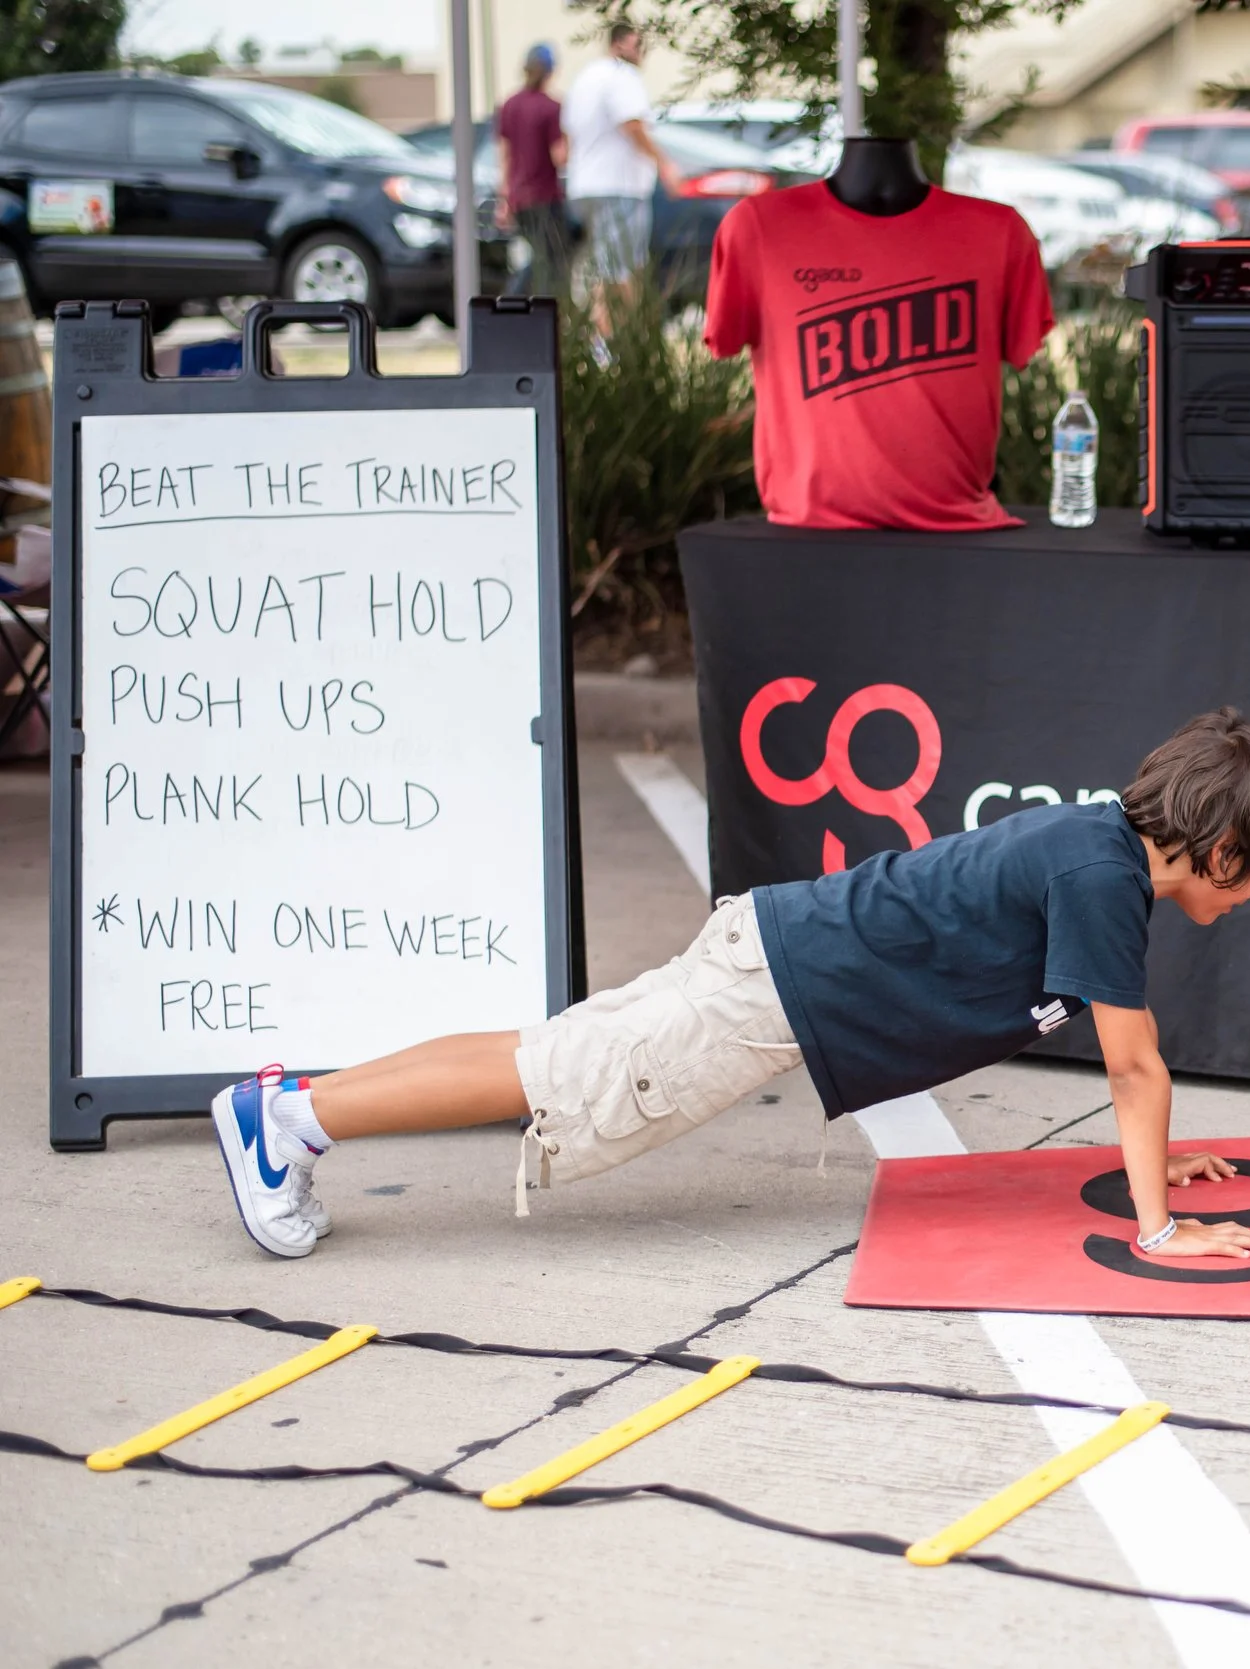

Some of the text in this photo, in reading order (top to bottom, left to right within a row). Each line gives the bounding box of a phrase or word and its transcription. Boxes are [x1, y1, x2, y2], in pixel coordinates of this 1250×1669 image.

[804, 288, 972, 392] BOLD
[99, 458, 521, 518] BEAT THE TRAINER
[111, 567, 513, 642] SQUAT HOLD
[111, 665, 385, 735] PUSH UPS
[106, 763, 439, 830] PLANK HOLD
[274, 903, 368, 951] ONE
[384, 914, 517, 964] WEEK
[161, 980, 278, 1033] FREE
